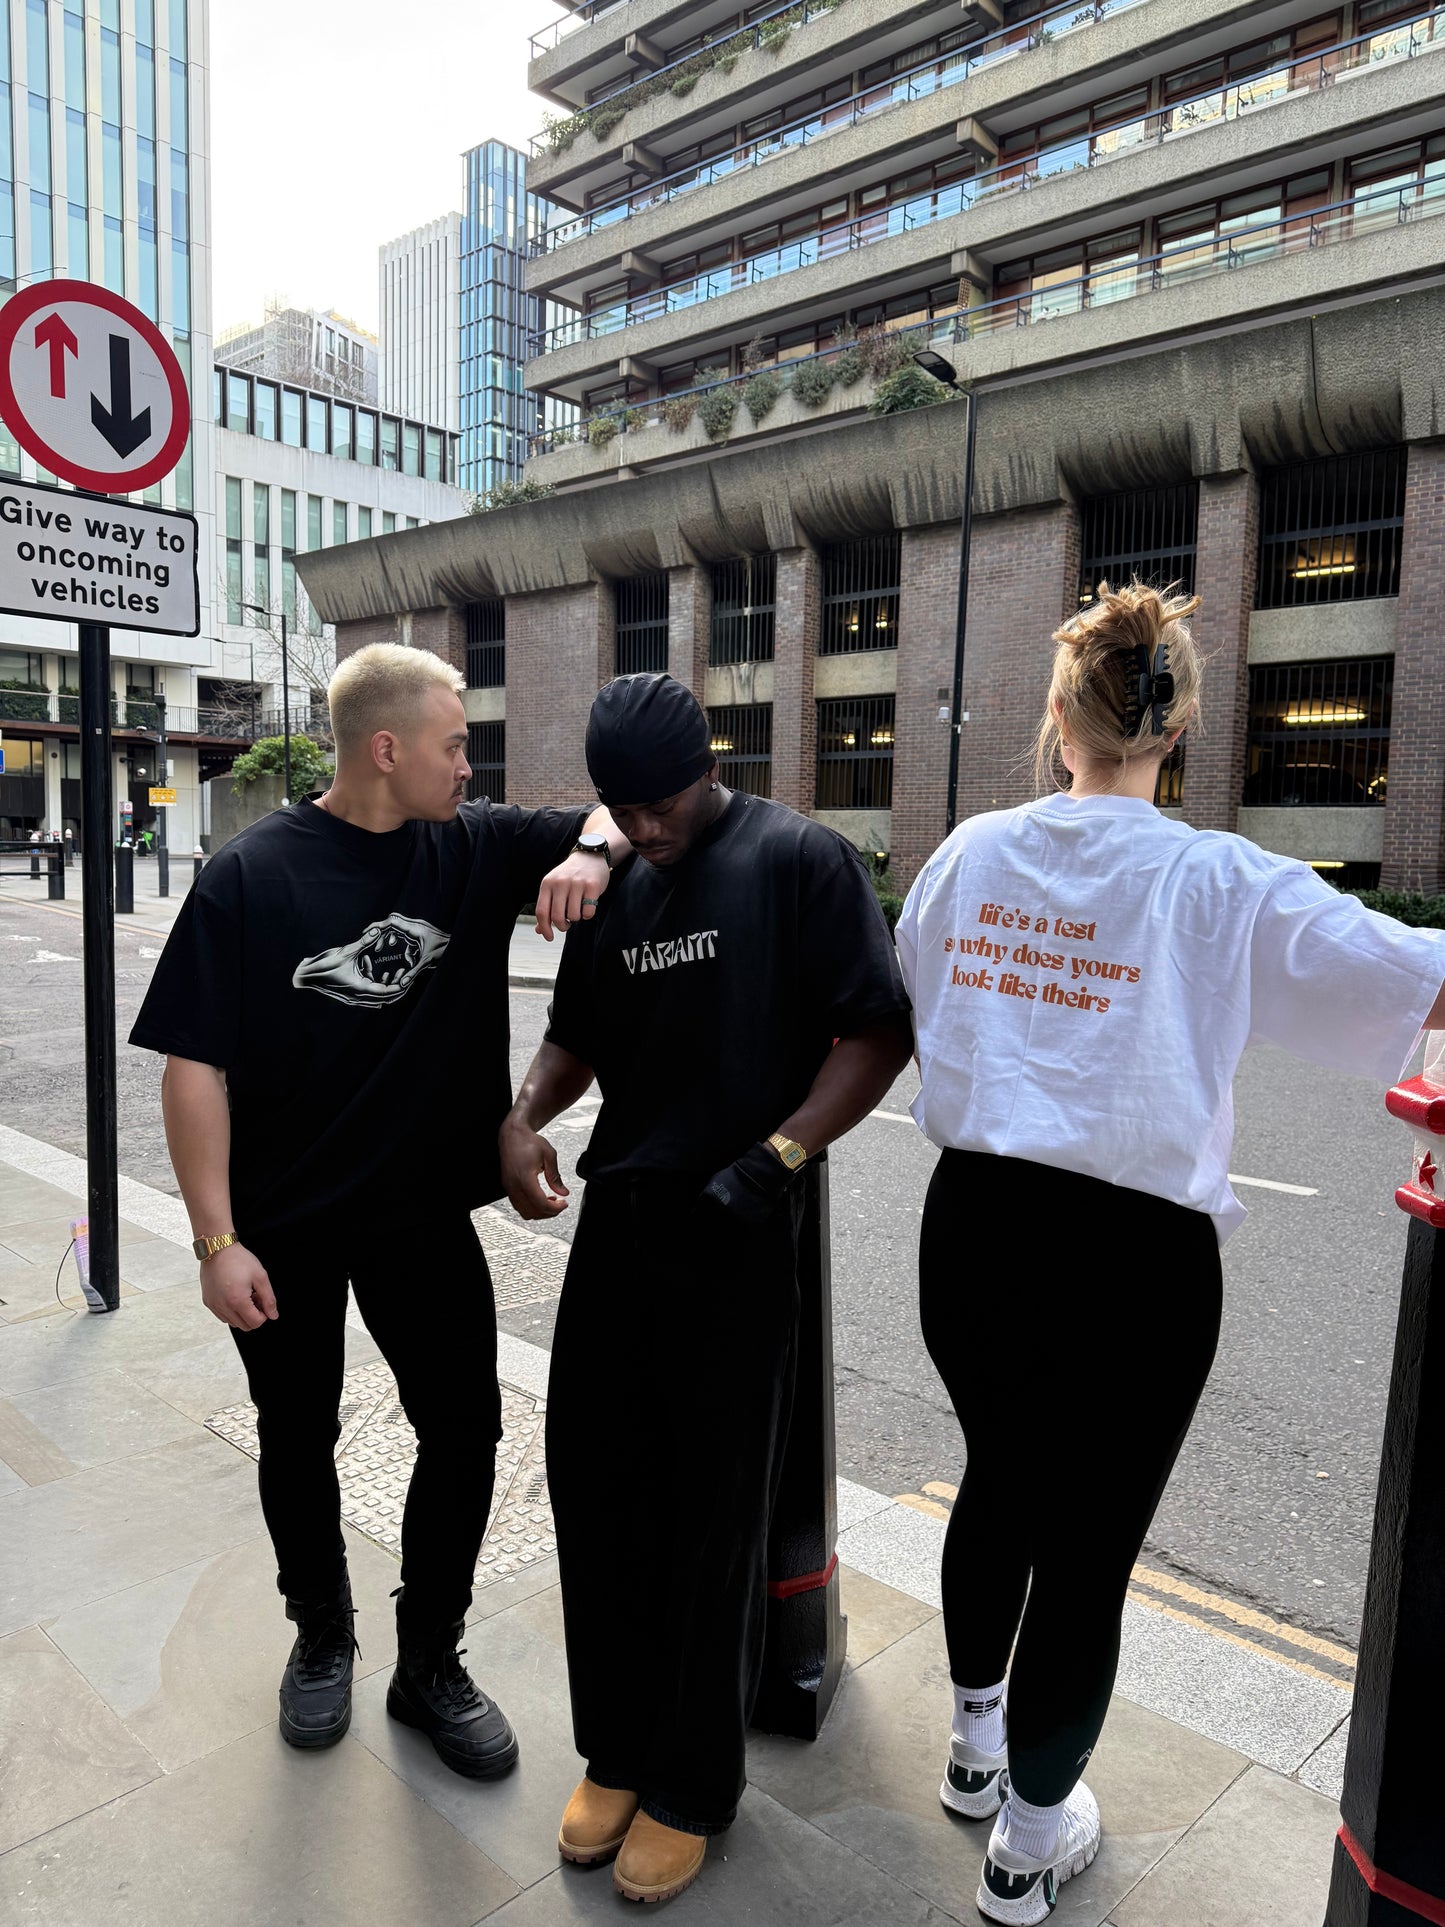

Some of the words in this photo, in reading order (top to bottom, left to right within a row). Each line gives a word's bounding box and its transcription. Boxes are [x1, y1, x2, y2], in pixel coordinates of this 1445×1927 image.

[0, 496, 72, 533] Give
[84, 518, 145, 550] way
[156, 526, 185, 553] to
[17, 541, 170, 588] oncoming
[31, 577, 160, 614] vehicles
[978, 903, 1030, 930] life's
[1034, 917, 1048, 934] a
[1053, 917, 1097, 941] test
[960, 936, 1008, 965] why
[1012, 944, 1065, 970] does
[1071, 957, 1141, 983] yours
[952, 965, 994, 991] look
[998, 973, 1038, 1000] like
[1042, 982, 1111, 1013] theirs
